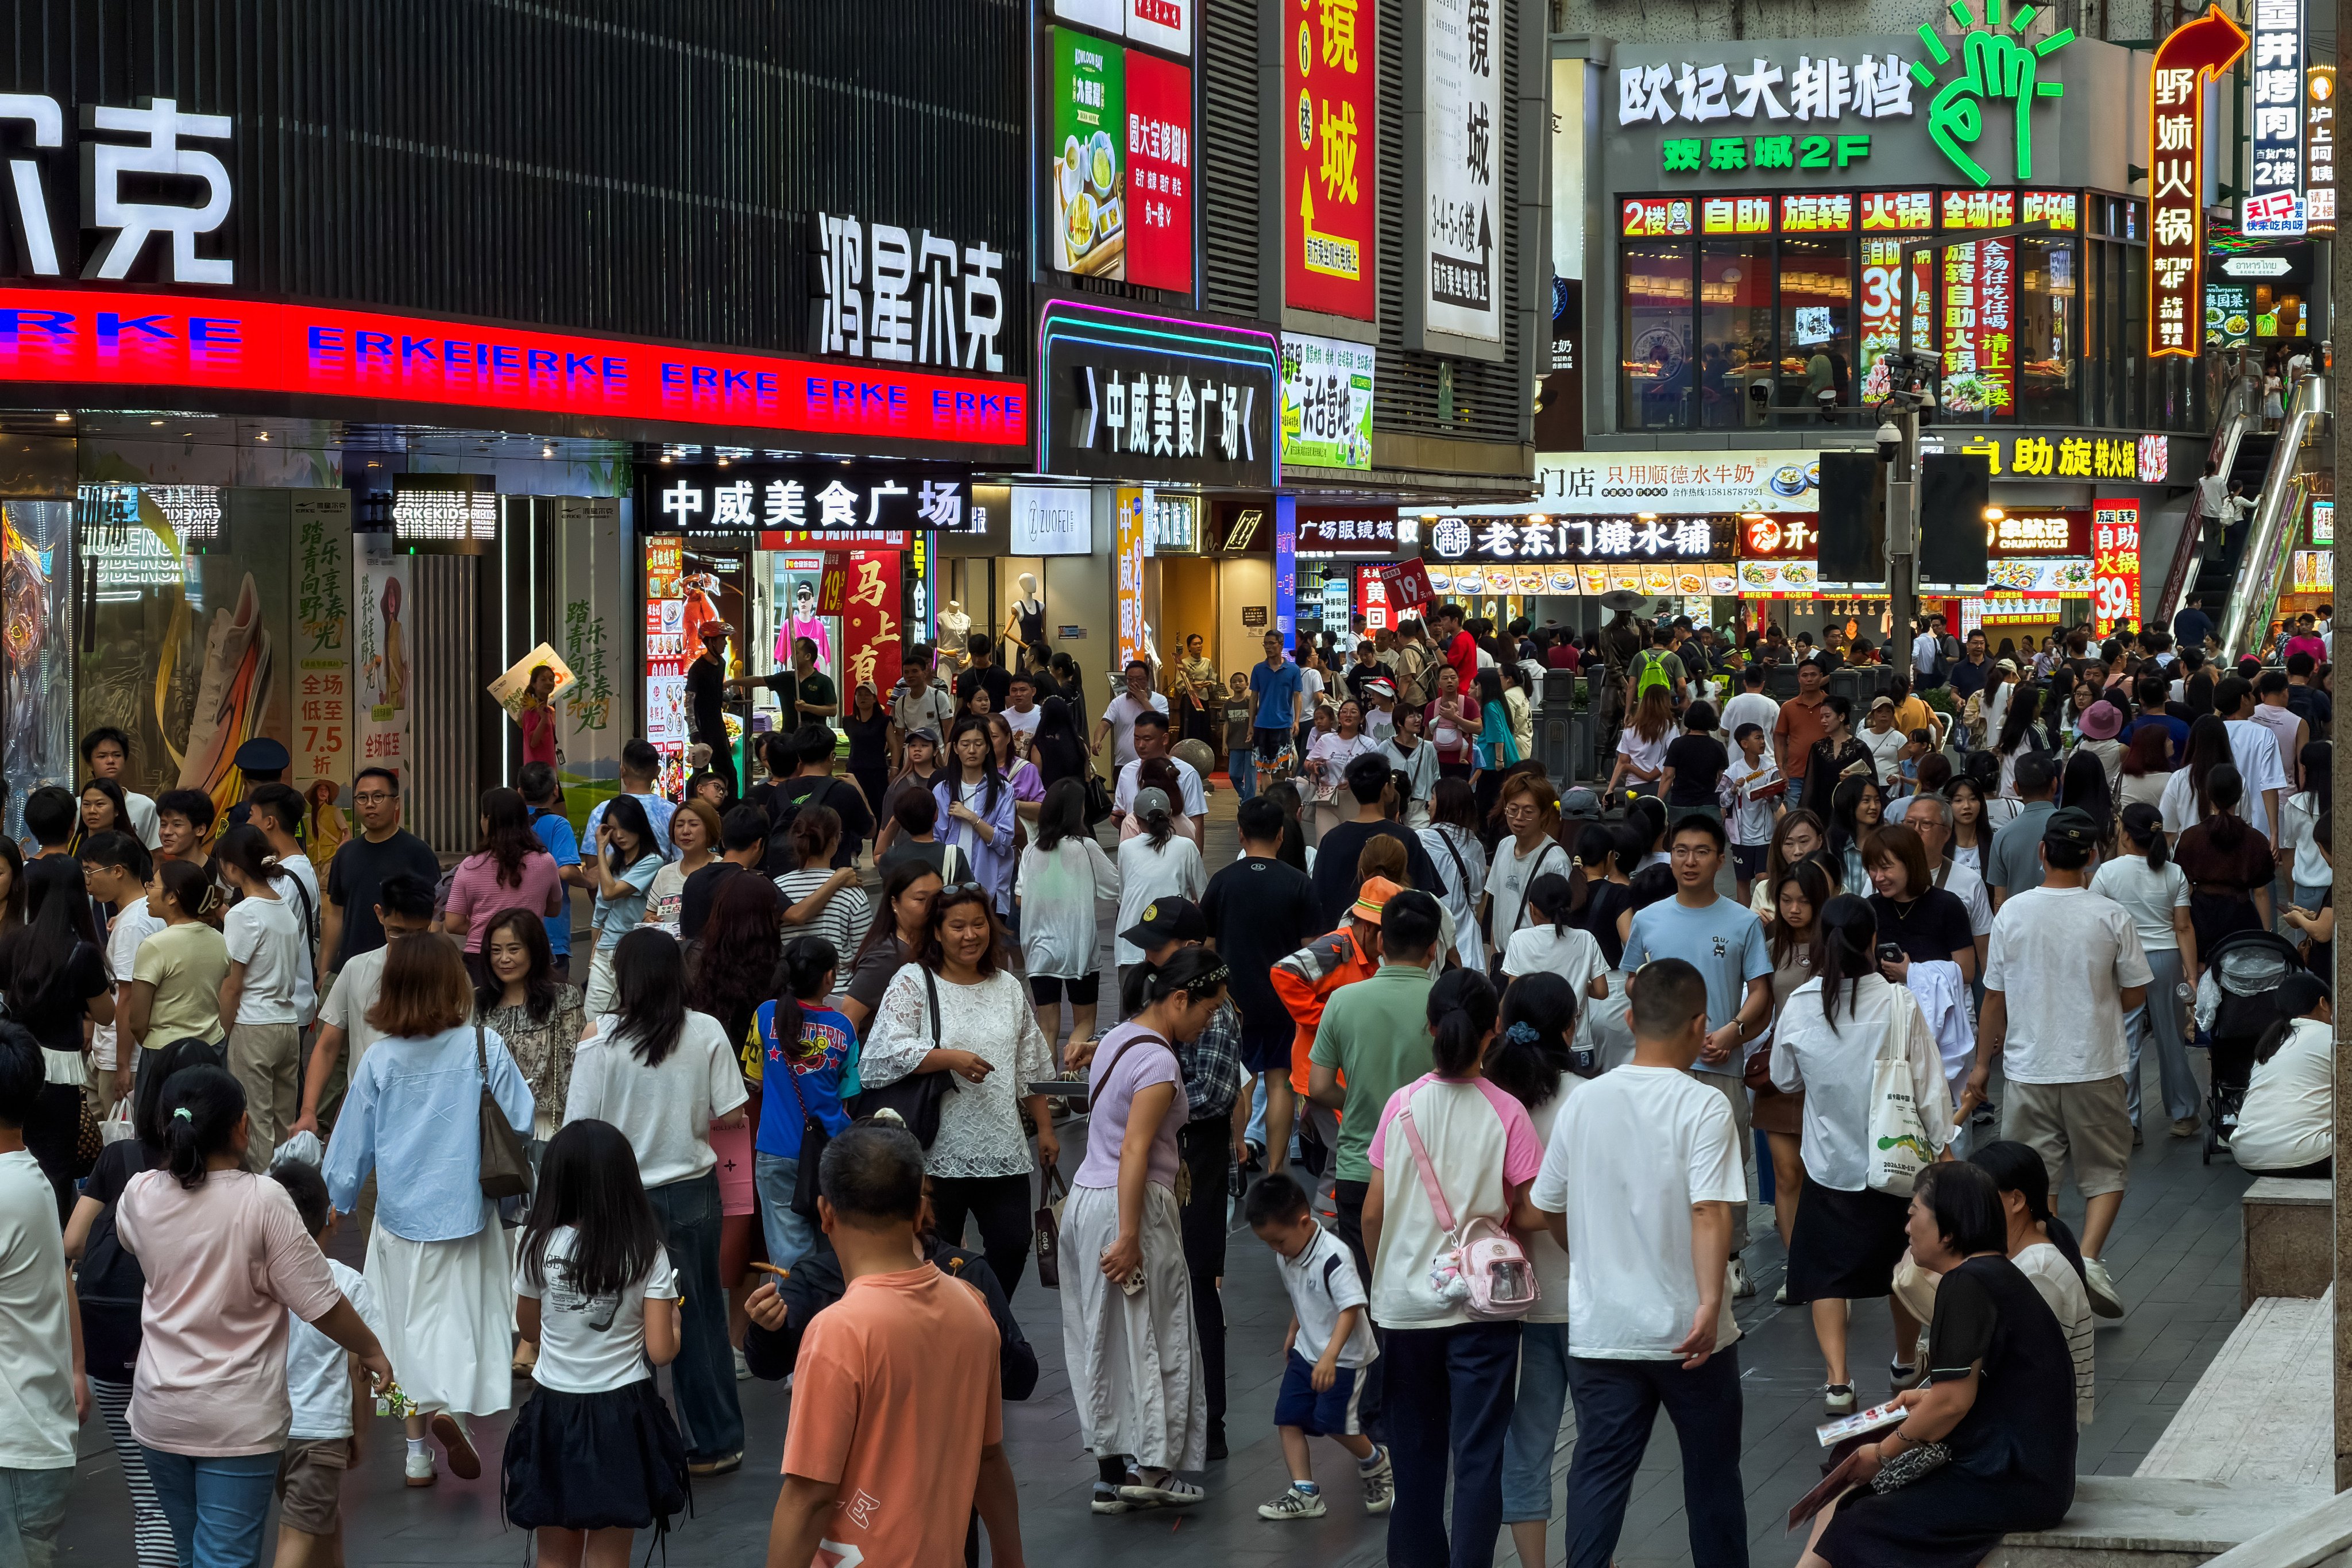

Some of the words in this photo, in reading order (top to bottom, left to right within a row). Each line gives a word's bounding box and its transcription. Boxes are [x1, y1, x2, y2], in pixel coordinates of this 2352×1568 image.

[1075, 48, 1095, 65] KOWLOON
[1619, 53, 1913, 125] 欧记大排档
[1130, 113, 1181, 165] 圆大宝修脚
[2309, 107, 2333, 181] 沪上阿姨
[1663, 134, 1871, 172] 欢乐城2F
[2256, 148, 2296, 160] 百货广场
[1136, 168, 1144, 187] 足疗
[1172, 177, 1181, 196] 养生
[2255, 161, 2296, 185] 2楼
[1944, 192, 2013, 228] 全场任
[2247, 193, 2295, 223] 친구
[2295, 202, 2303, 218] 朋友
[2311, 191, 2334, 203] 请上
[1146, 199, 1164, 227] 负一楼
[1625, 202, 1666, 235] 2楼
[1705, 199, 1770, 232] 自助
[1783, 195, 1851, 230] 旋转
[1863, 193, 1931, 229] 火锅
[2023, 193, 2076, 230] 吃任喝
[2312, 204, 2334, 217] 2楼
[1432, 194, 1474, 254] 3-4-5-6楼
[2246, 221, 2304, 231] 快来吃肉呀
[1307, 236, 1358, 272] 前方乘坐观光电梯上
[1871, 241, 1932, 265] 自助锅
[820, 212, 1003, 372] 鸿星尔克
[1434, 260, 1488, 300] 前方乘坐电梯上
[1979, 240, 2011, 330] 全场任吃任喝
[2160, 271, 2185, 288] 4F
[1943, 241, 1976, 372] 旋转自助火锅
[2160, 297, 2183, 308] 上午
[2206, 293, 2243, 307] 泰国菜
[1863, 315, 1930, 336] 一人锅
[2160, 308, 2183, 319] 10点
[308, 326, 471, 364] ERKE
[493, 345, 628, 379] ERKE
[1864, 333, 1930, 350] 全场吃
[2162, 334, 2183, 345] 2点
[661, 362, 778, 393] ERKE
[1979, 333, 2012, 407] 请上二楼
[807, 377, 907, 404] ERKE
[933, 389, 1021, 414] ERKE
[1107, 369, 1238, 461] 中威美食广场
[1303, 374, 1350, 439] 天台营地
[1605, 464, 1755, 485] 只用顺德水牛奶
[393, 508, 470, 519] ERKEKIDS
[663, 480, 962, 527] 中威美食广场
[2097, 510, 2137, 523] 旋转
[1040, 509, 1069, 533] ZUOFEI
[1299, 520, 1395, 540] 广场眼镜城
[1397, 519, 1419, 543] 收
[1478, 520, 1711, 555] 老东门糖水铺
[1783, 521, 1818, 550] 开
[2098, 525, 2139, 550] 自助
[2096, 551, 2139, 574] 火锅
[1366, 581, 1387, 604] 黄
[2096, 577, 2127, 619] 39
[2096, 620, 2140, 636] 请楼
[302, 674, 343, 695] 全场
[302, 700, 343, 720] 低至
[302, 726, 343, 752] 7.5
[365, 732, 400, 758] 全场低至
[313, 755, 331, 775] 折
[769, 1017, 847, 1052] HTERIC
